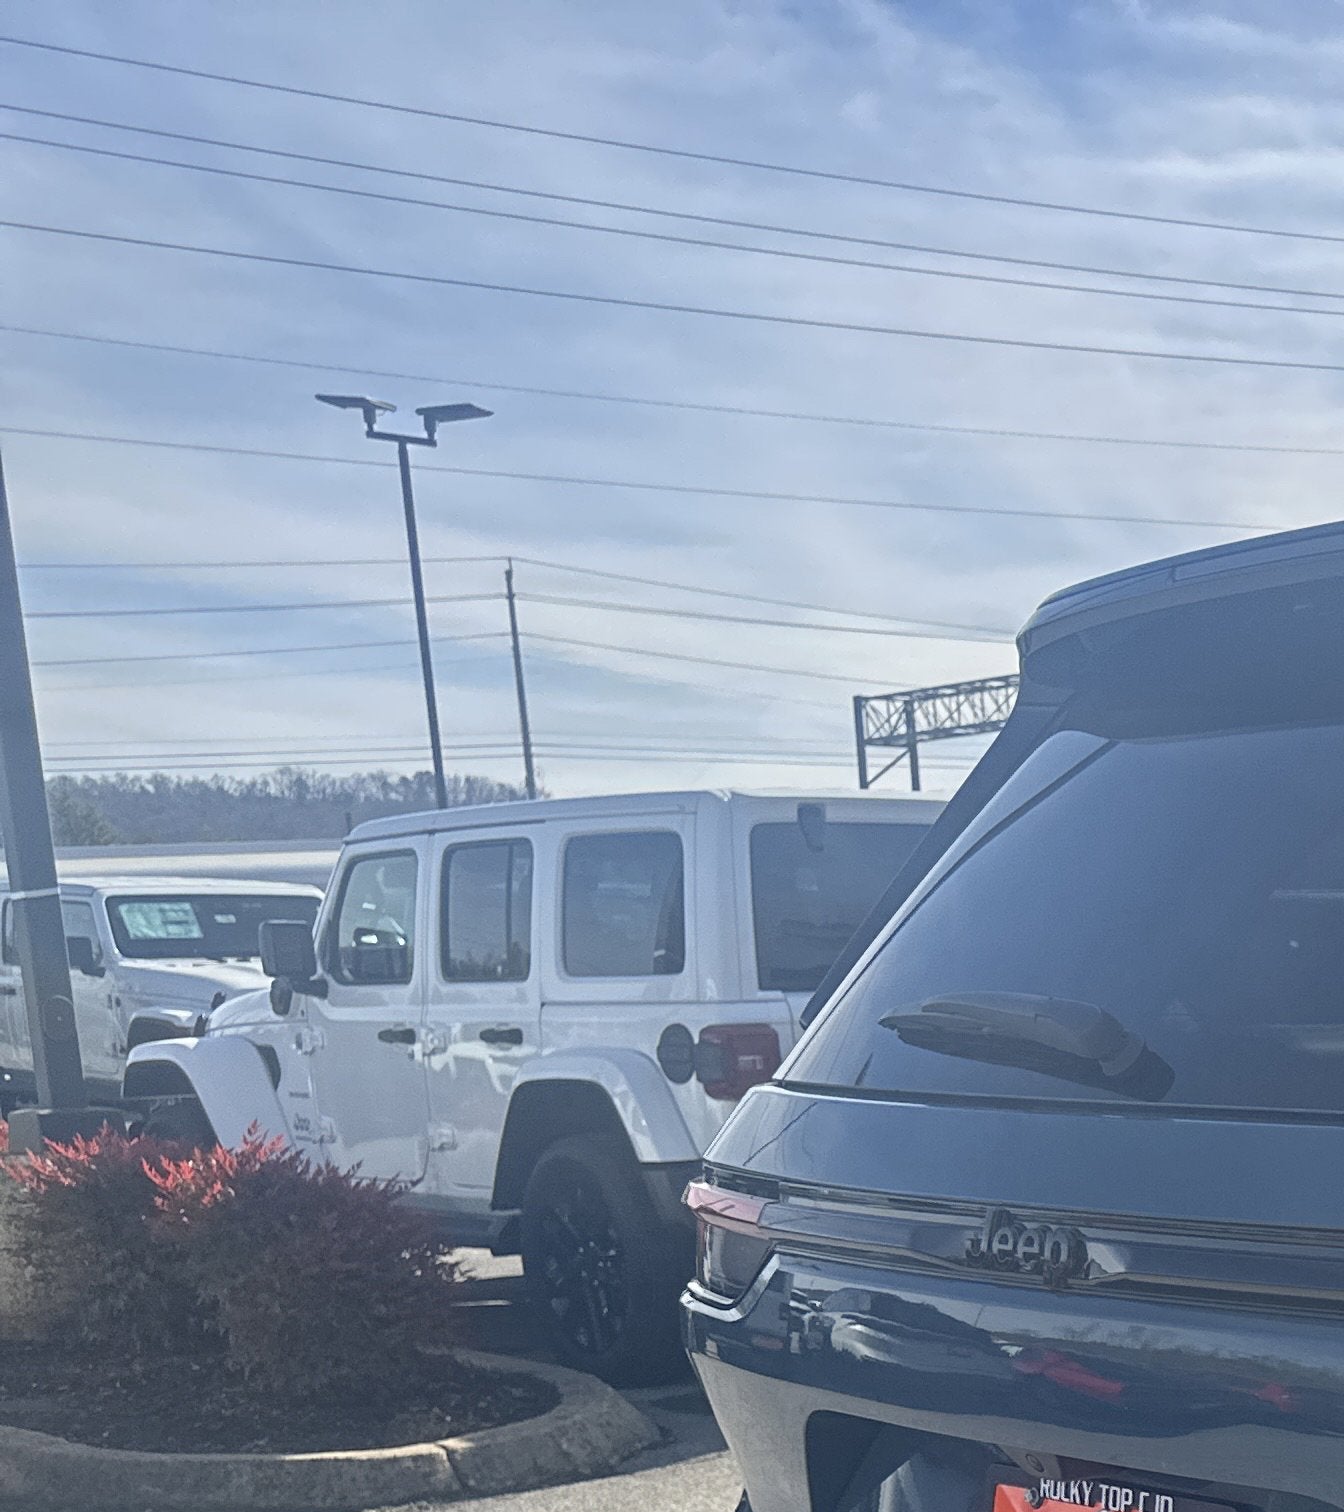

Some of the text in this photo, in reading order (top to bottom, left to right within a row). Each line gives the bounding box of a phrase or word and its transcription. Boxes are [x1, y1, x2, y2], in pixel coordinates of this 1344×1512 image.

[965, 1207, 1078, 1280] Jeep
[1040, 1478, 1094, 1506] ROCKY
[1099, 1484, 1133, 1512] TOP
